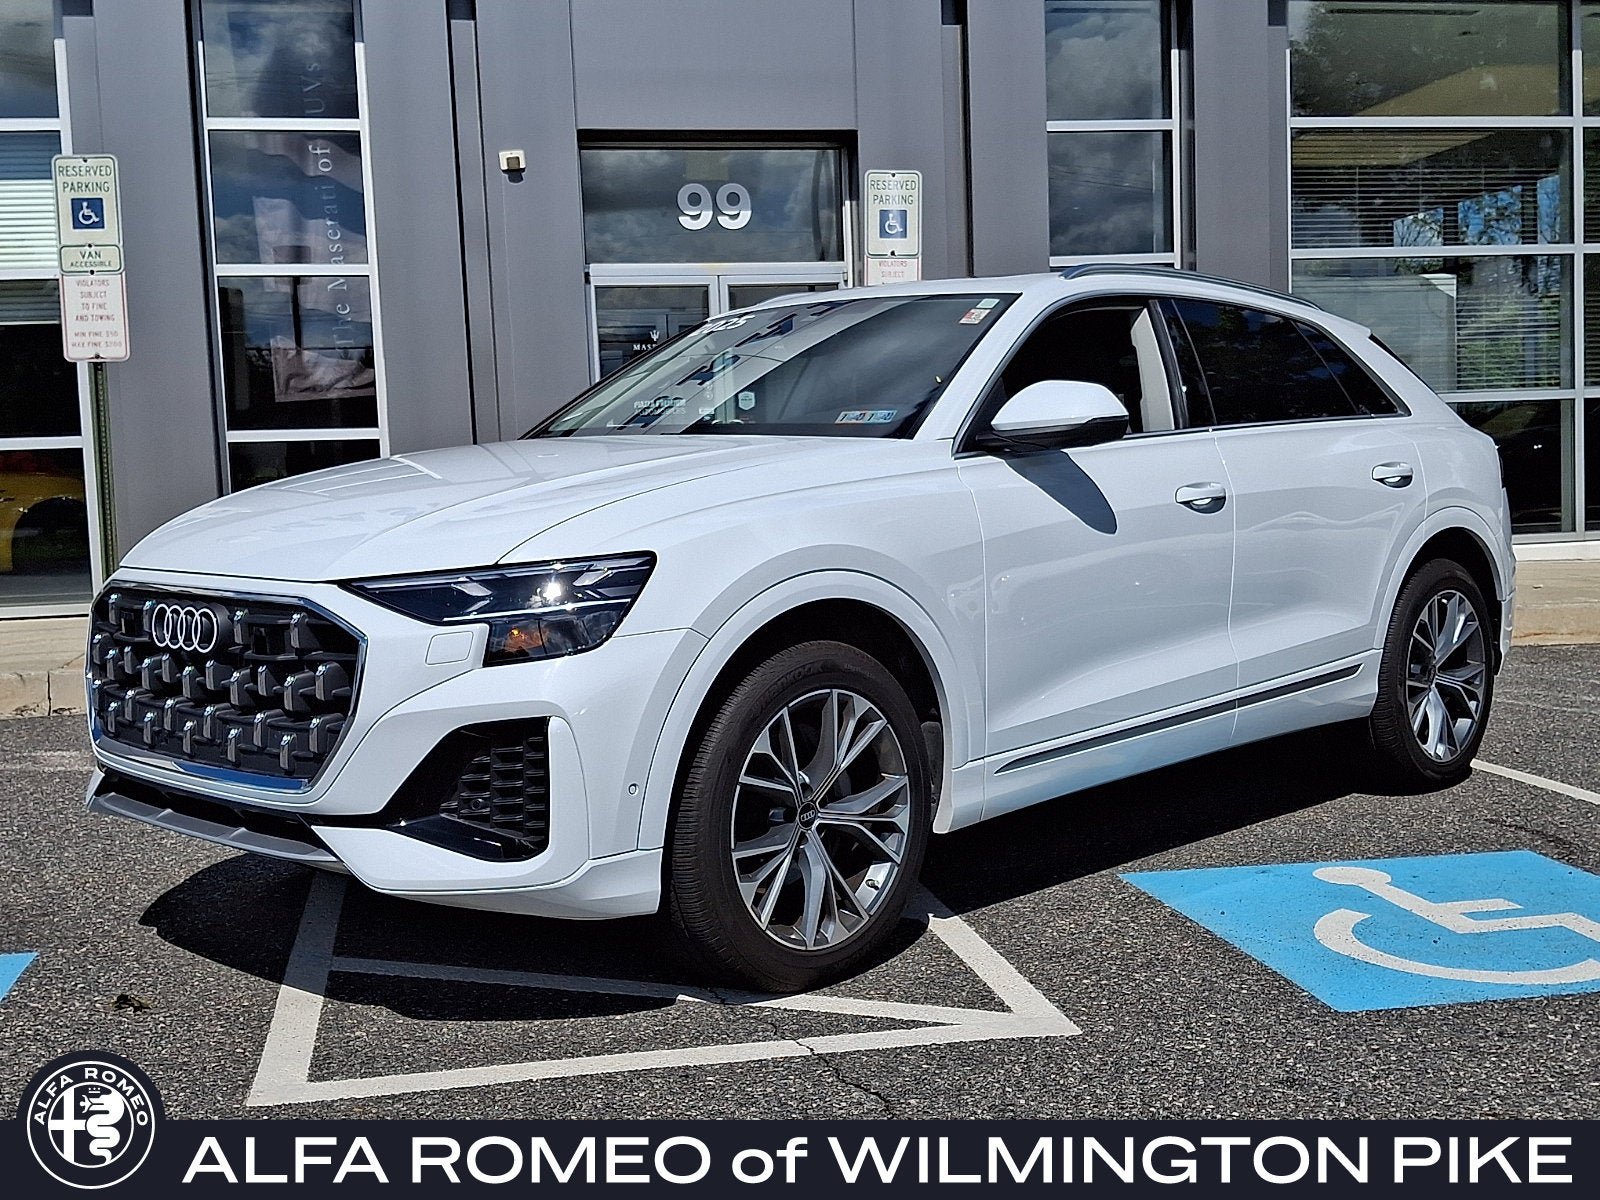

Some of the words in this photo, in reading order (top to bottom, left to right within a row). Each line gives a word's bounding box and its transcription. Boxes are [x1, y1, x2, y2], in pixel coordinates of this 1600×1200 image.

[308, 144, 333, 172] of
[58, 165, 112, 177] RESERVED
[62, 181, 110, 193] PARKING
[870, 180, 917, 191] RESERVED
[873, 194, 914, 205] PARKING
[677, 182, 752, 231] 99
[79, 250, 102, 259] VAN
[70, 260, 112, 268] ACCESSIBLE
[881, 270, 904, 278] SUBJECT
[76, 279, 110, 287] VIOLATORS
[80, 291, 107, 299] SUBJECT
[81, 302, 90, 310] TO
[92, 302, 107, 310] FINE
[75, 314, 89, 322] AND
[91, 314, 115, 322] TOWING
